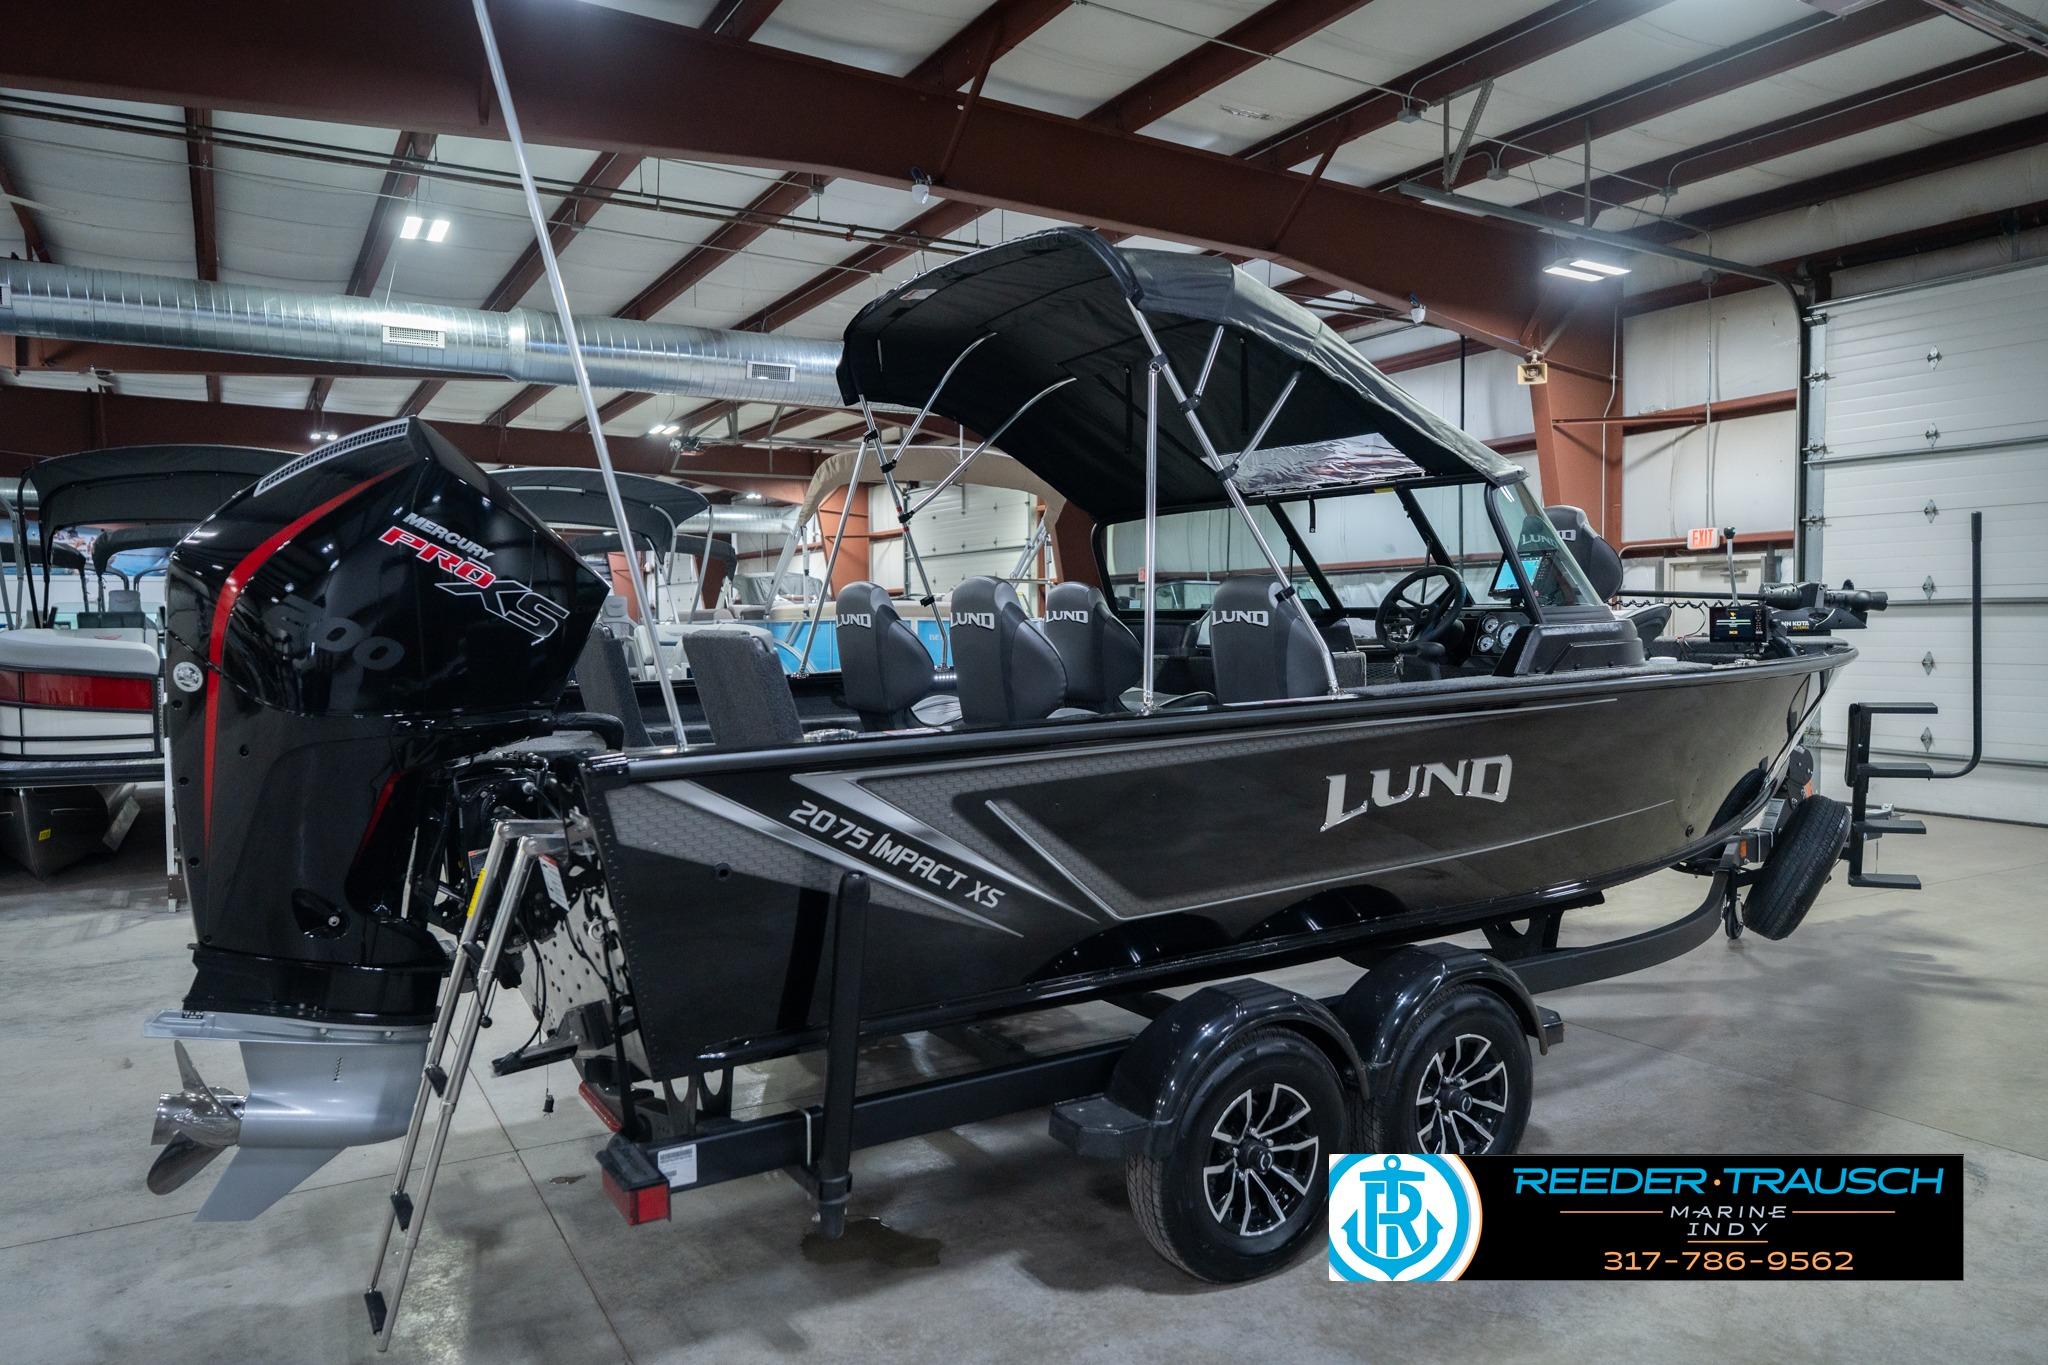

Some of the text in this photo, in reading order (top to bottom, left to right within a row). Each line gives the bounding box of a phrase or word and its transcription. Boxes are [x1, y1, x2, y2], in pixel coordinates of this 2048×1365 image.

[402, 512, 496, 560] MERCURY
[1692, 528, 1714, 547] EXIT
[378, 525, 497, 589] PRO
[434, 557, 569, 638] XS
[835, 613, 872, 628] LUND
[950, 612, 995, 630] LUND
[1045, 610, 1089, 624] LUND
[1211, 610, 1270, 627] LUND
[1320, 753, 1513, 832] LUND
[789, 800, 1006, 908] 2075 IMPACT XS
